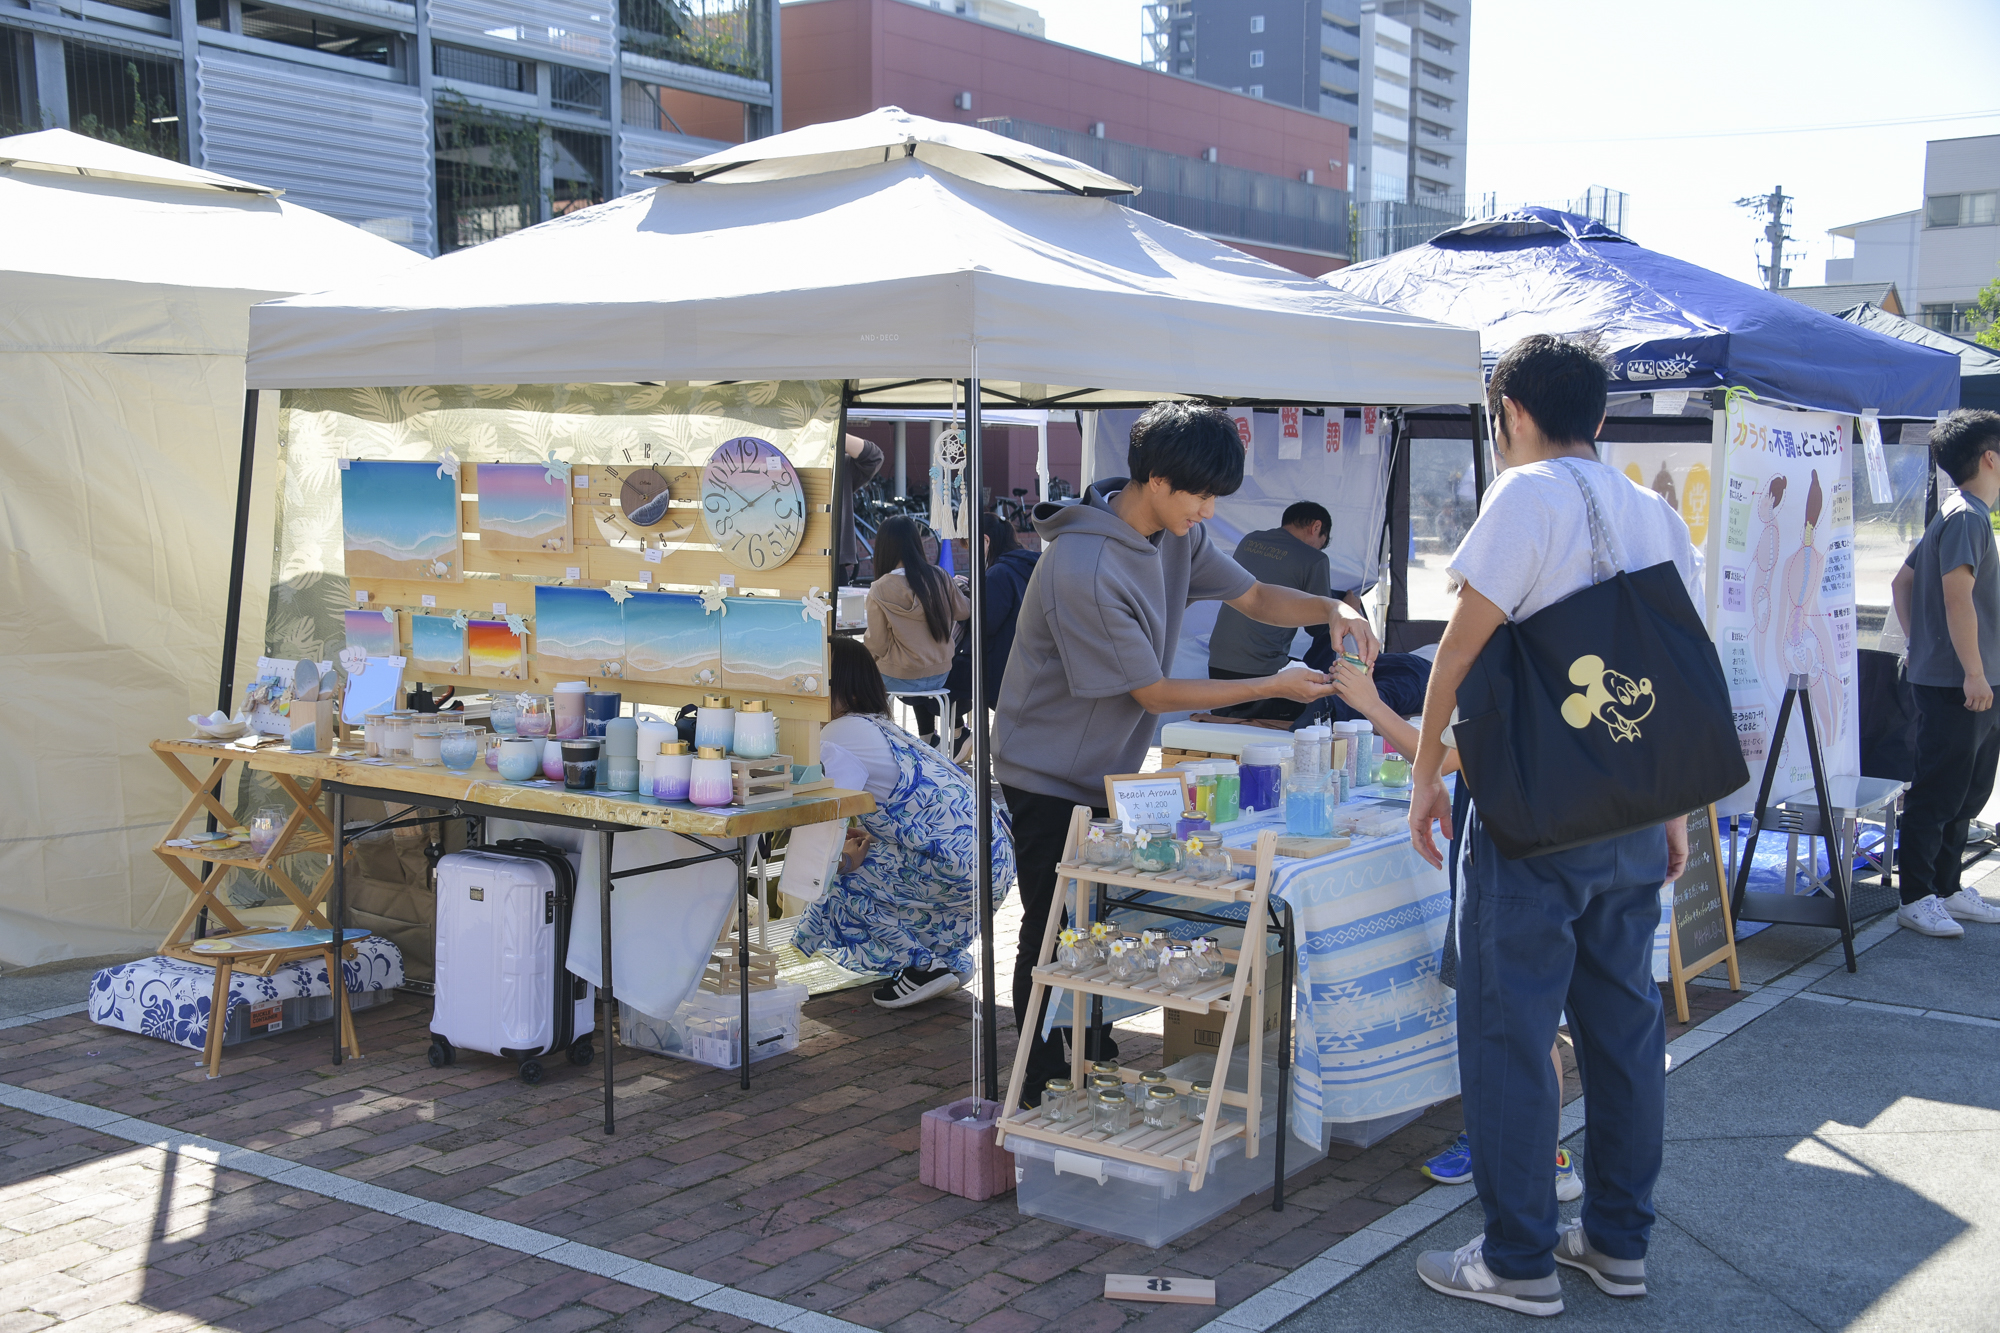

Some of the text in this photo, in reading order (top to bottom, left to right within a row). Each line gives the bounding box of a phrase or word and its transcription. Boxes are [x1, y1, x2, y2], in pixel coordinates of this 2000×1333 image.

[644, 443, 651, 458] 12
[739, 439, 760, 474] 12
[720, 448, 739, 475] 11
[708, 465, 729, 494] 10
[771, 471, 792, 493] 2
[704, 492, 731, 513] 9
[774, 497, 803, 519] 3
[715, 515, 734, 536] 8
[774, 523, 796, 540] 4
[640, 536, 645, 552] 6
[731, 529, 746, 551] 7
[748, 533, 765, 568] 6
[767, 531, 786, 557] 5
[1118, 788, 1178, 799] Beach Aroma
[1133, 801, 1168, 810] 大 ¥1,200
[1146, 812, 1170, 820] ¥1,000
[253, 1013, 278, 1024] CONTAINER
